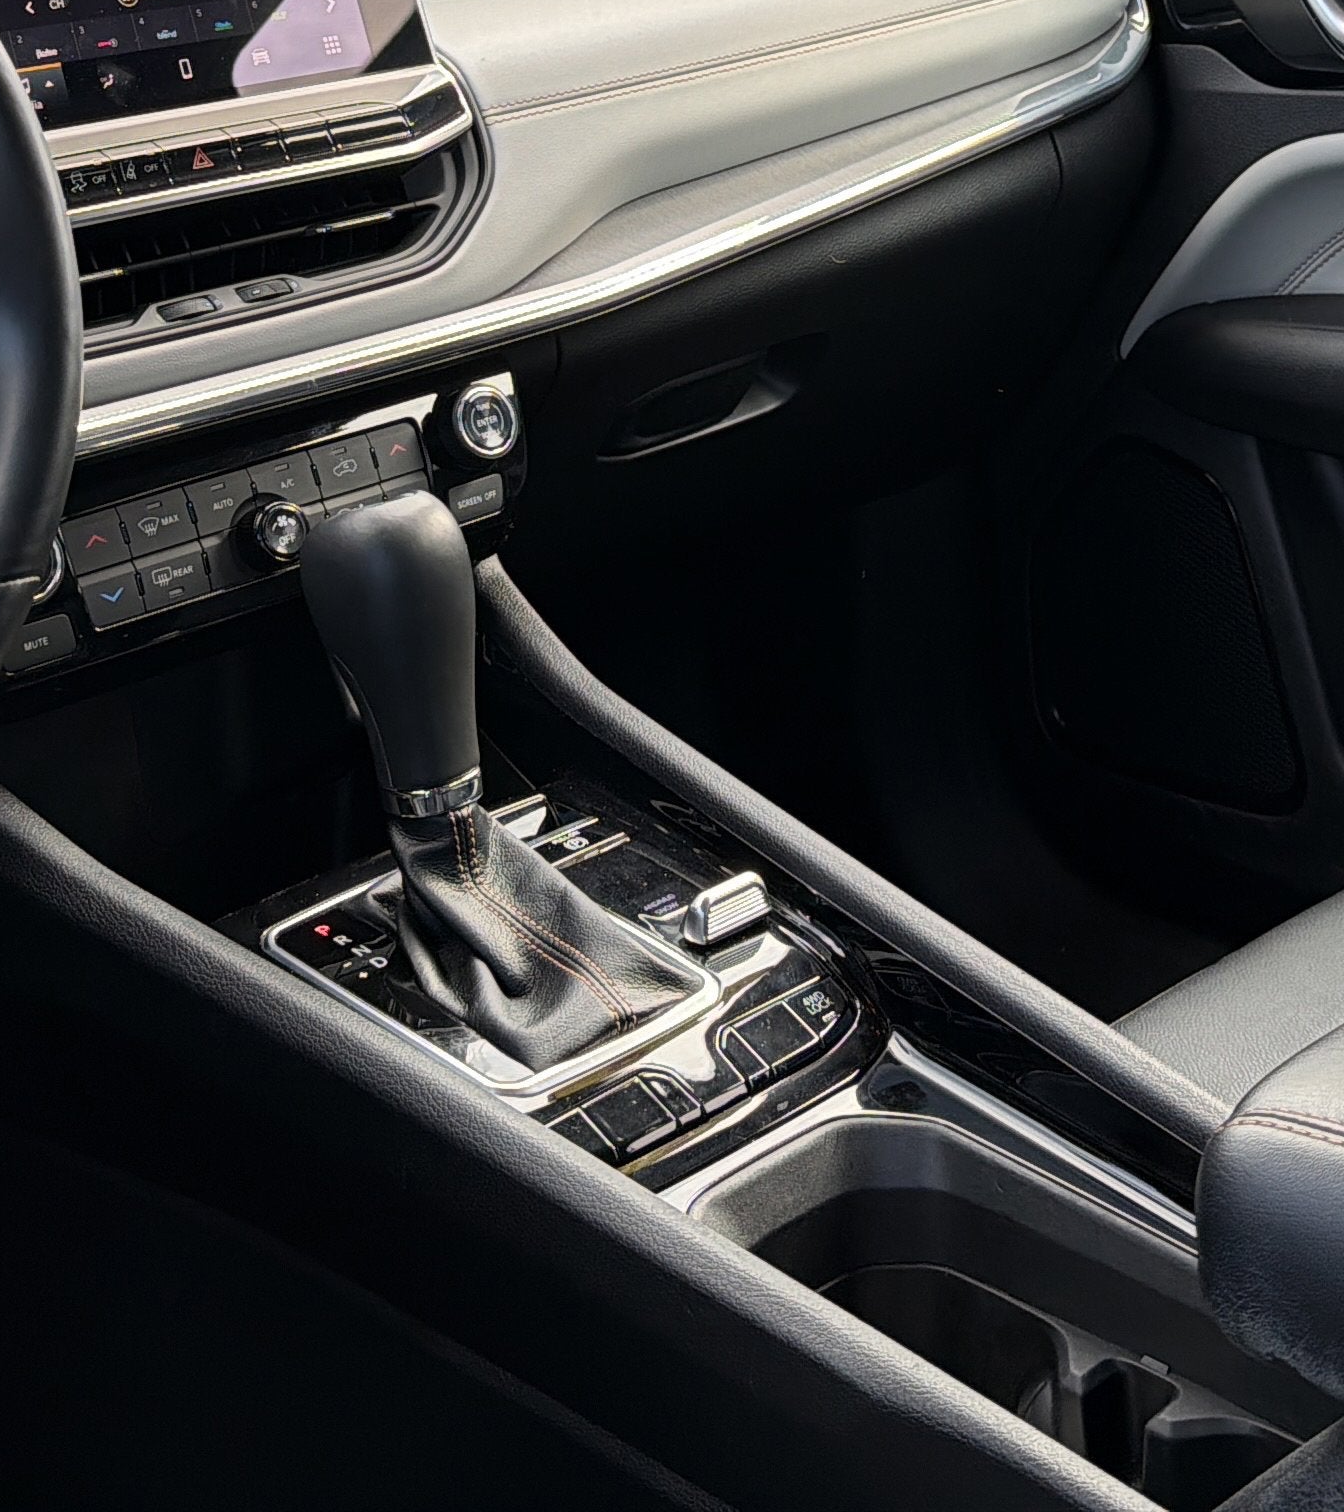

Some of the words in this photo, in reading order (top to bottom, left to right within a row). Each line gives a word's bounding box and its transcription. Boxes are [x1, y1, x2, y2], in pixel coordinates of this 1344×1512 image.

[196, 8, 203, 18] 5
[138, 17, 145, 26] 4
[78, 25, 85, 35] 3
[16, 35, 23, 44] 2
[91, 172, 107, 185] OFF
[476, 414, 498, 428] ENTER
[280, 477, 296, 490] A/C
[212, 497, 235, 512] AUTO
[457, 494, 483, 510] SCREEN
[484, 489, 497, 502] OFF
[161, 513, 180, 528] MAX
[278, 532, 297, 548] OFF
[172, 564, 194, 579] REAR
[23, 634, 50, 651] MUTE
[313, 924, 331, 937] P
[332, 934, 353, 946] R
[350, 943, 373, 958] N
[368, 956, 389, 968] D
[802, 990, 826, 1007] 4WD
[806, 998, 835, 1016] LOCK
